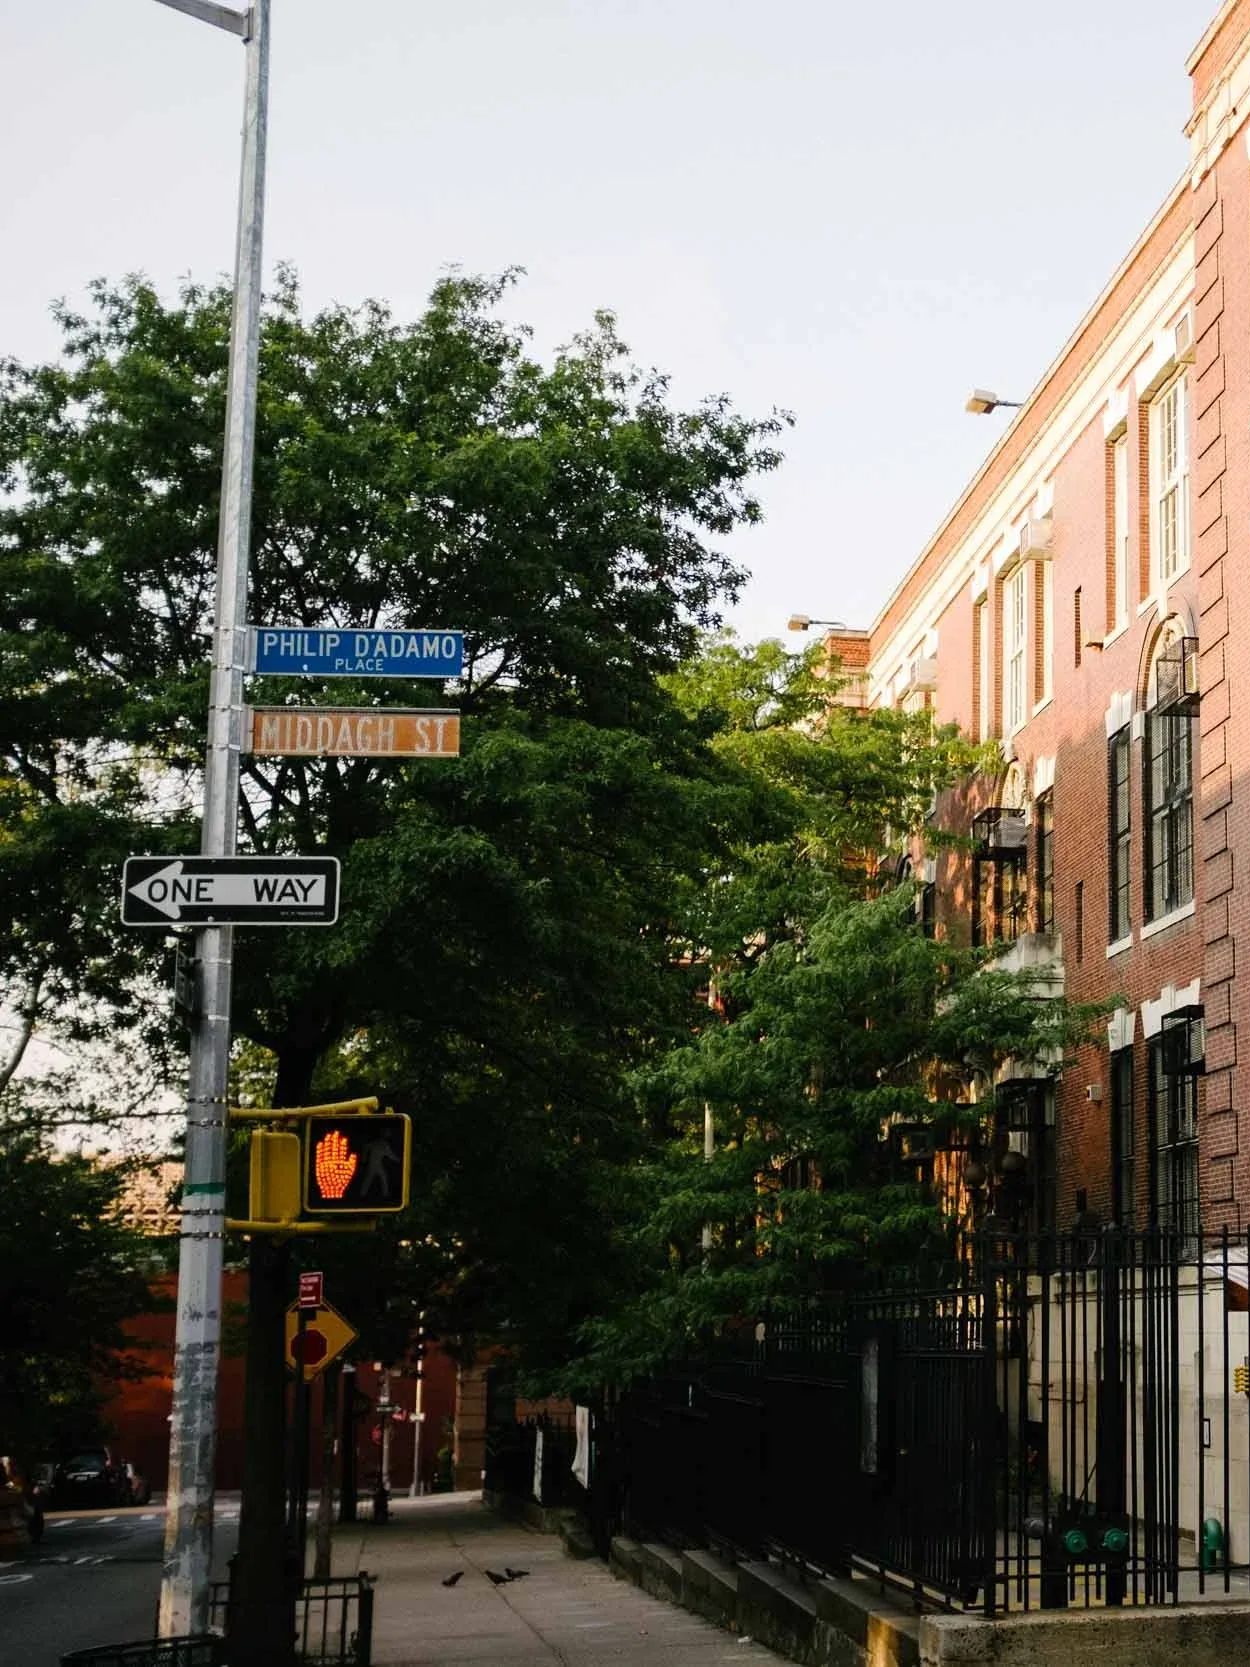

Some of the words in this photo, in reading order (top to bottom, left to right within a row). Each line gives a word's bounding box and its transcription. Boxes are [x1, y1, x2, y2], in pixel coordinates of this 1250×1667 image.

[263, 632, 341, 657] PHILIP
[354, 633, 457, 659] D'ADAMO
[334, 658, 384, 672] PLACE
[260, 715, 395, 753] MIDDAGH
[414, 717, 449, 753] ST
[147, 877, 214, 903] ONE
[252, 878, 319, 903] WAY
